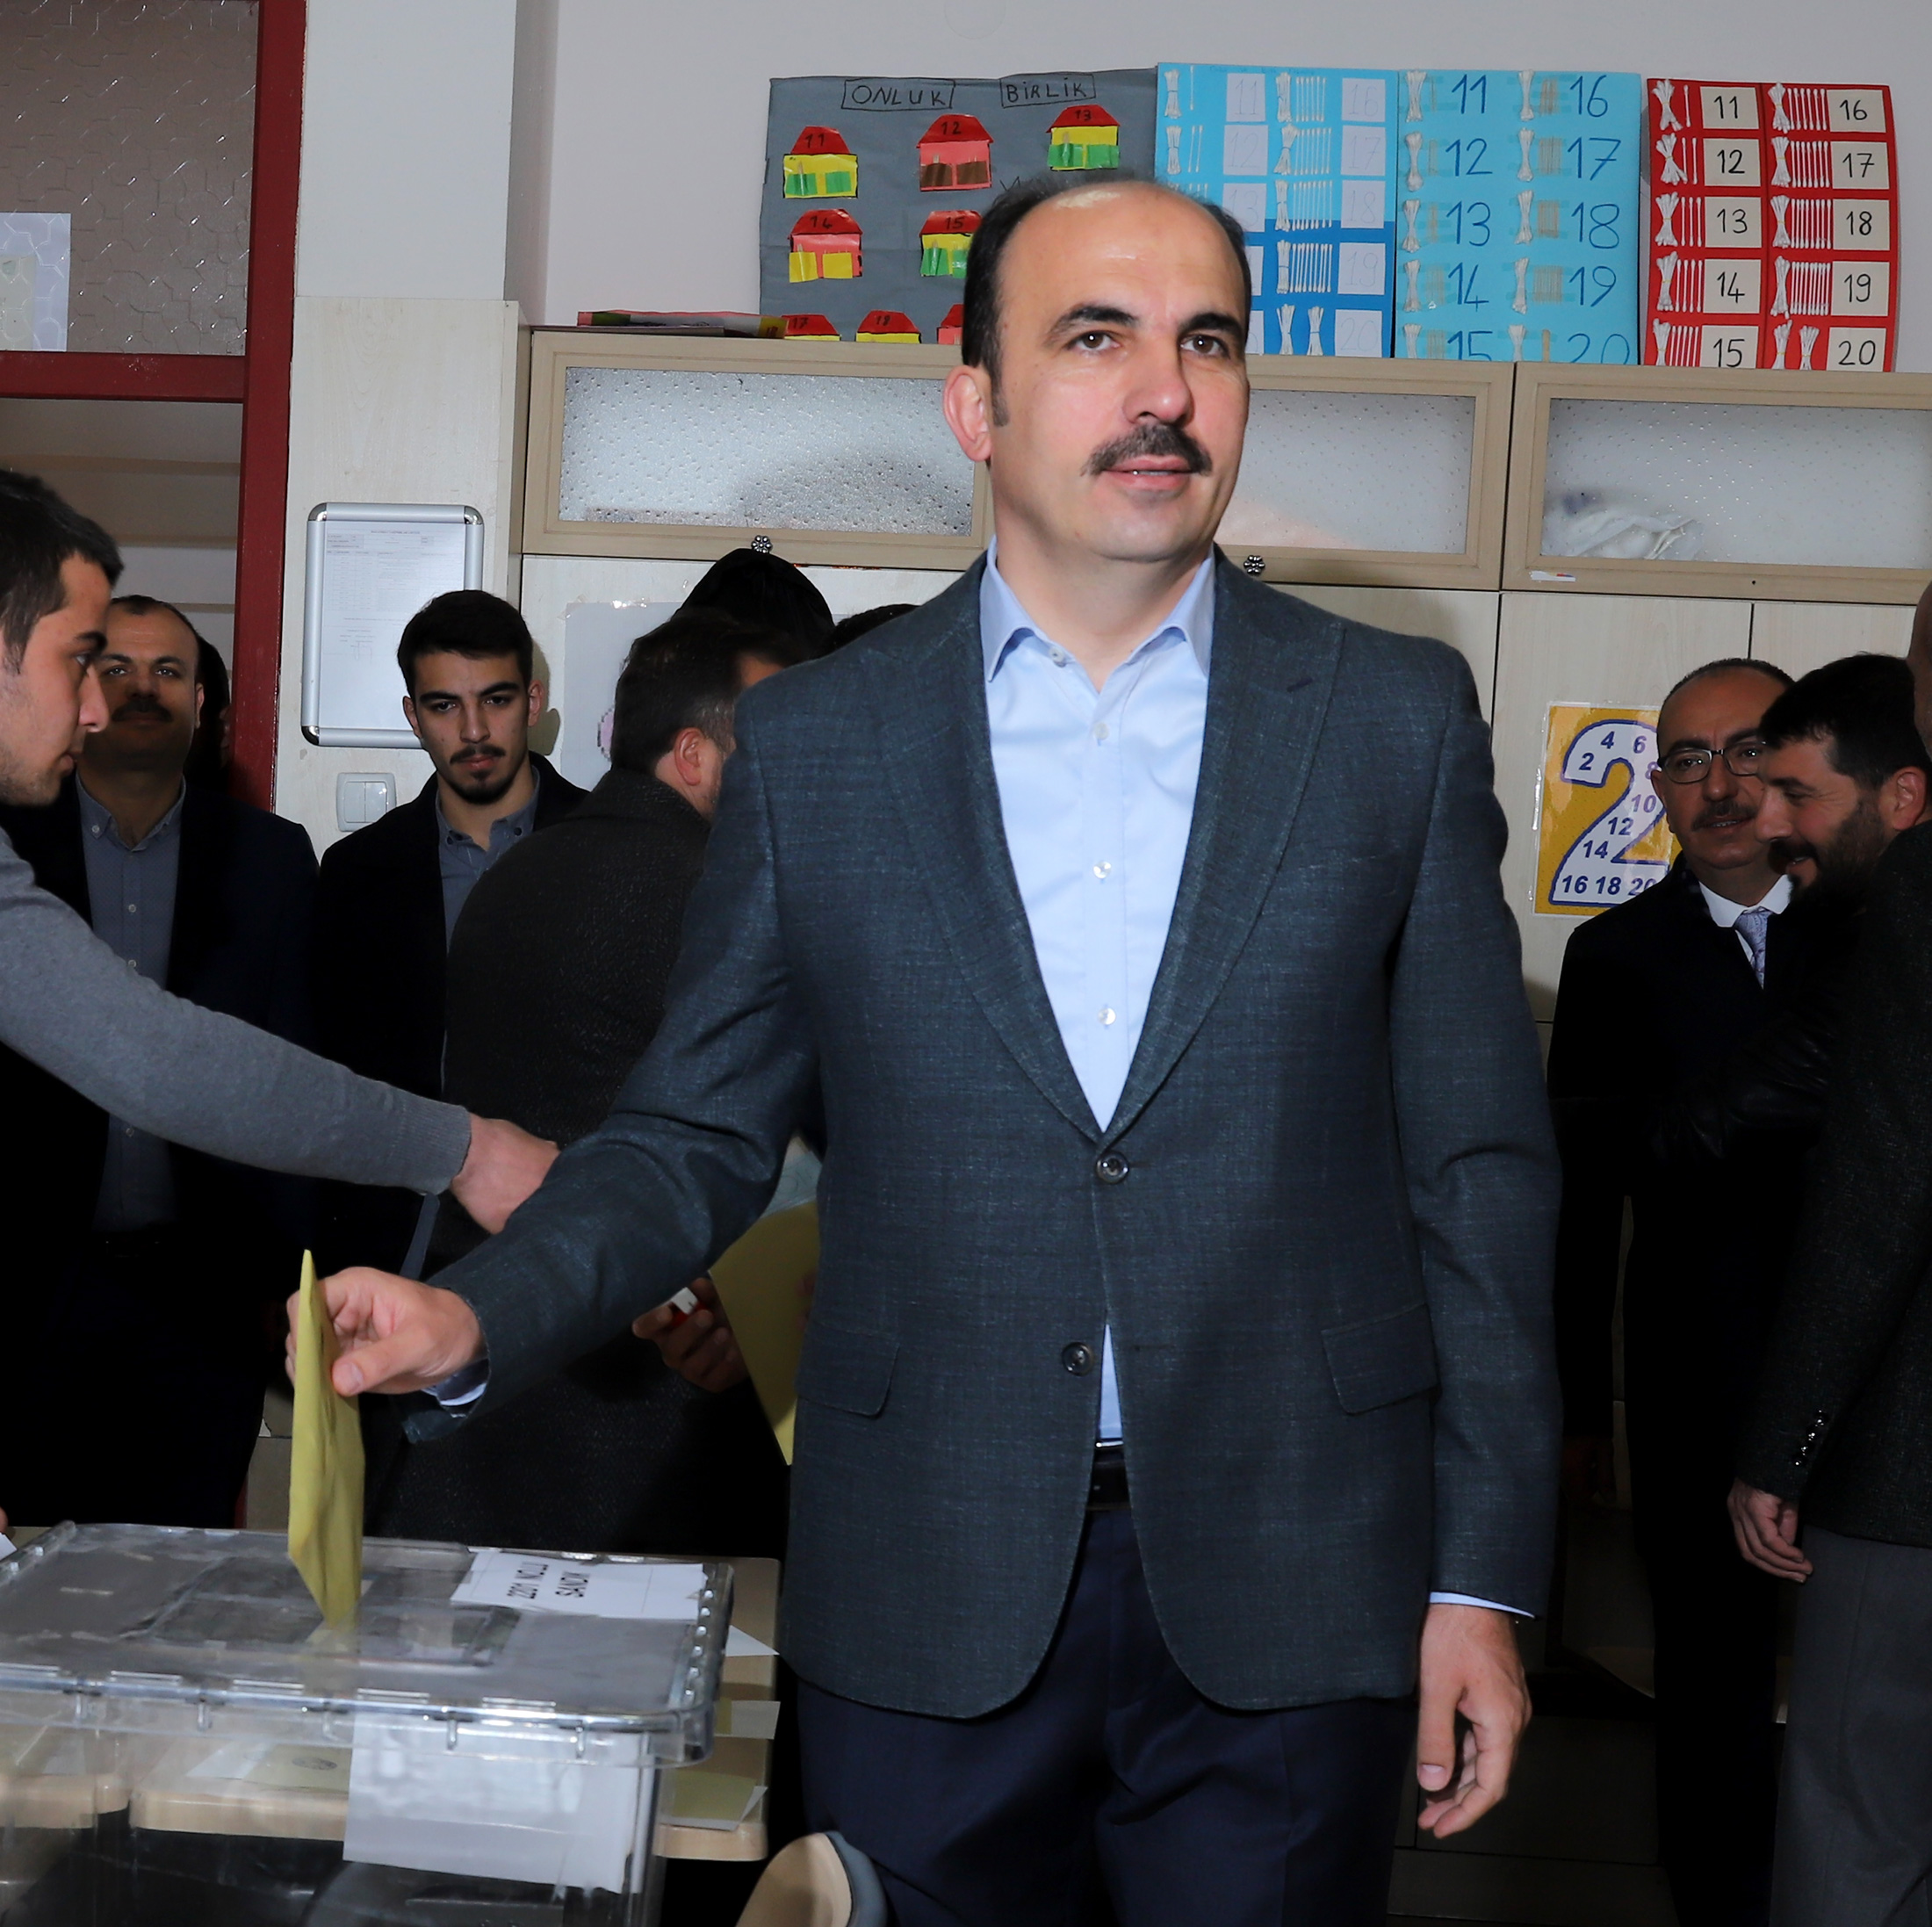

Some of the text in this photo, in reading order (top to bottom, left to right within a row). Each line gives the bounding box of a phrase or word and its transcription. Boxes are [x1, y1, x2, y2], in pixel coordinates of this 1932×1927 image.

[852, 84, 946, 106] ONLUK
[1232, 80, 1261, 115] 11
[1349, 84, 1379, 117] 16
[1451, 74, 1488, 115] 11
[1569, 75, 1608, 118] 16
[1713, 95, 1739, 119] 11
[1074, 109, 1092, 121] 13
[1839, 99, 1868, 120] 16
[804, 133, 825, 149] 11
[941, 120, 962, 135] 12
[1228, 131, 1258, 170] 12
[1349, 134, 1381, 170] 17
[1445, 137, 1494, 177] 12
[1567, 136, 1621, 180] 17
[1717, 148, 1746, 174] 12
[1842, 153, 1875, 178] 17
[1349, 191, 1377, 223] 18
[1717, 208, 1748, 234] 13
[944, 216, 964, 229] 15
[1445, 202, 1491, 247] 13
[1571, 203, 1620, 249] 18
[1846, 211, 1872, 235] 18
[1344, 251, 1379, 287] 19
[1447, 262, 1489, 309] 14
[1568, 265, 1618, 307] 19
[1717, 271, 1745, 303] 14
[1843, 273, 1871, 303] 19
[1340, 317, 1378, 351] 20
[1447, 330, 1492, 361] 15
[1567, 333, 1630, 364] 20
[1712, 338, 1745, 368] 15
[1839, 340, 1876, 366] 20
[1601, 731, 1615, 749] 4
[1633, 735, 1647, 754] 6
[1579, 753, 1595, 771] 2
[1645, 761, 1660, 780] 8
[1631, 794, 1657, 813] 10
[1607, 817, 1633, 836] 12
[1582, 840, 1608, 859] 14
[1561, 875, 1589, 894] 16
[1595, 877, 1622, 895] 18
